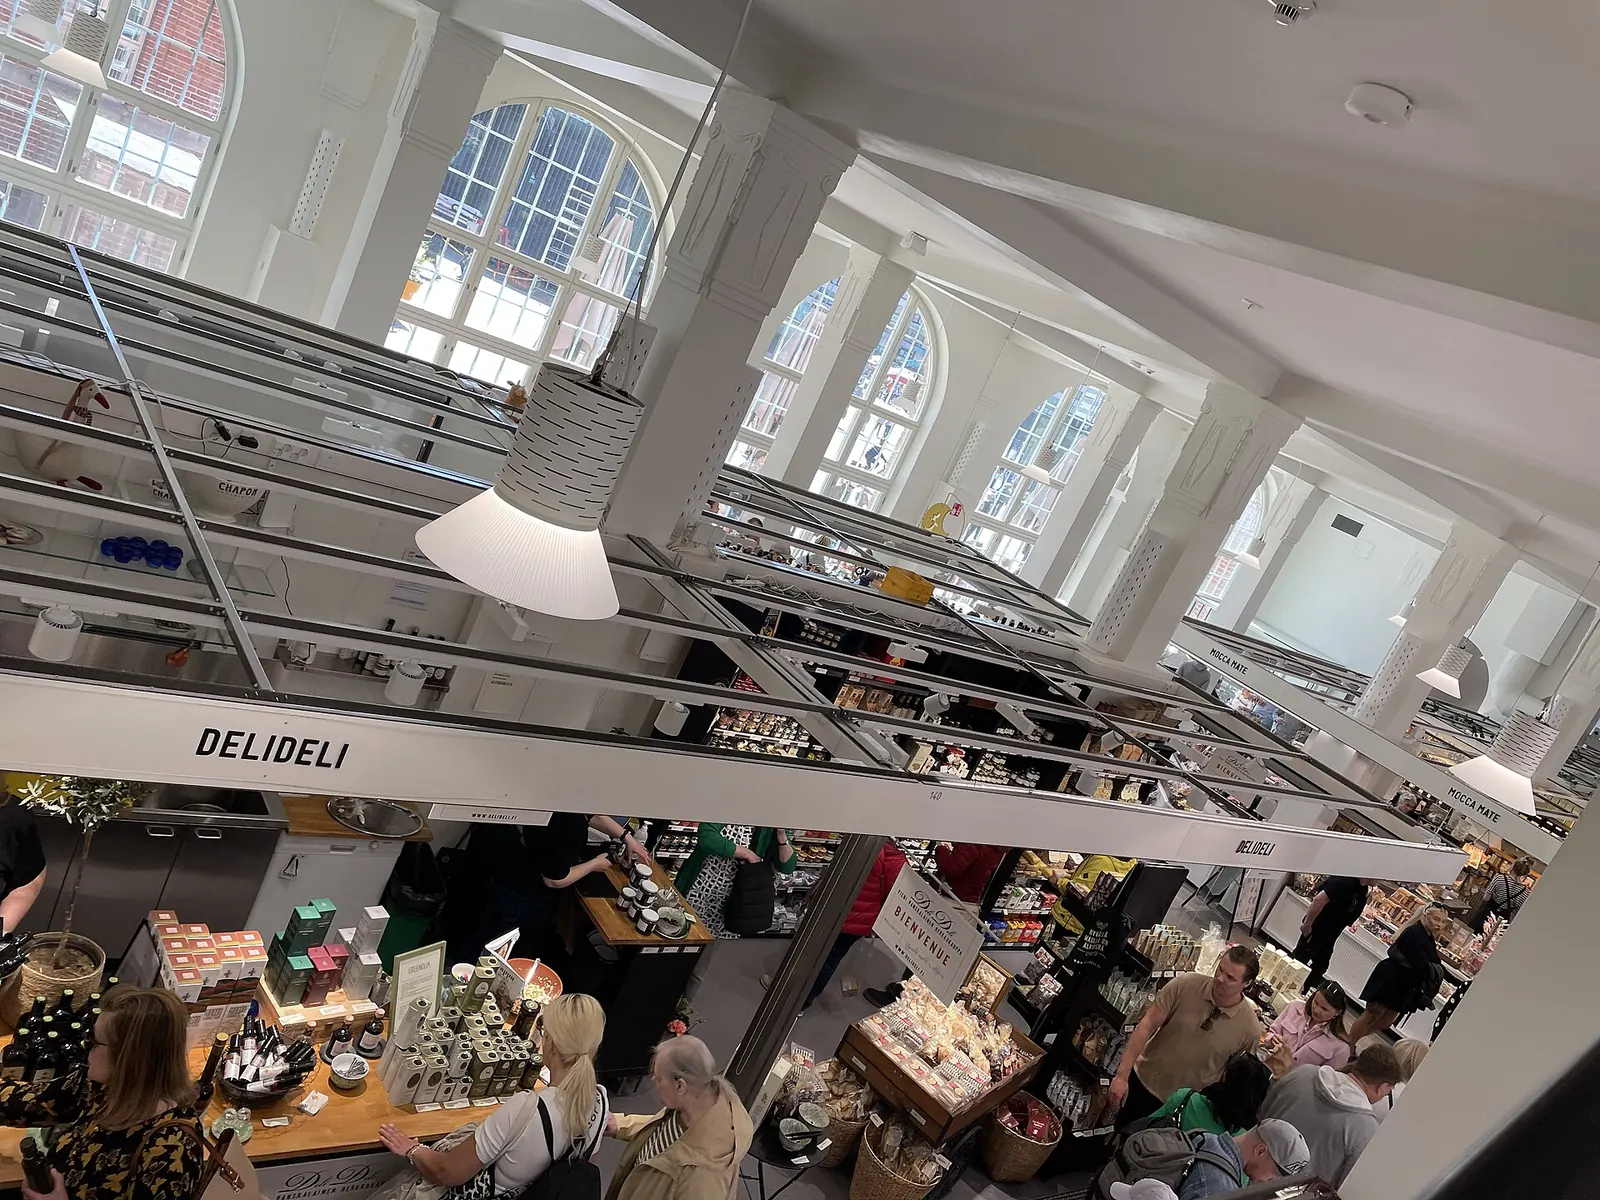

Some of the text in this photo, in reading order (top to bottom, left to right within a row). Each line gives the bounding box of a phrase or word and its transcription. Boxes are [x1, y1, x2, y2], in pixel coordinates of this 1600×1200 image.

[218, 482, 258, 496] CHAPON
[1209, 648, 1249, 675] MOCCA MATE
[195, 727, 350, 769] DELIDELI
[929, 791, 943, 801] 140
[1447, 787, 1501, 824] MOCCA MATE
[1235, 840, 1276, 856] DELIDELI
[894, 906, 951, 966] BIENVENUE
[278, 1164, 381, 1193] Deli Deli
